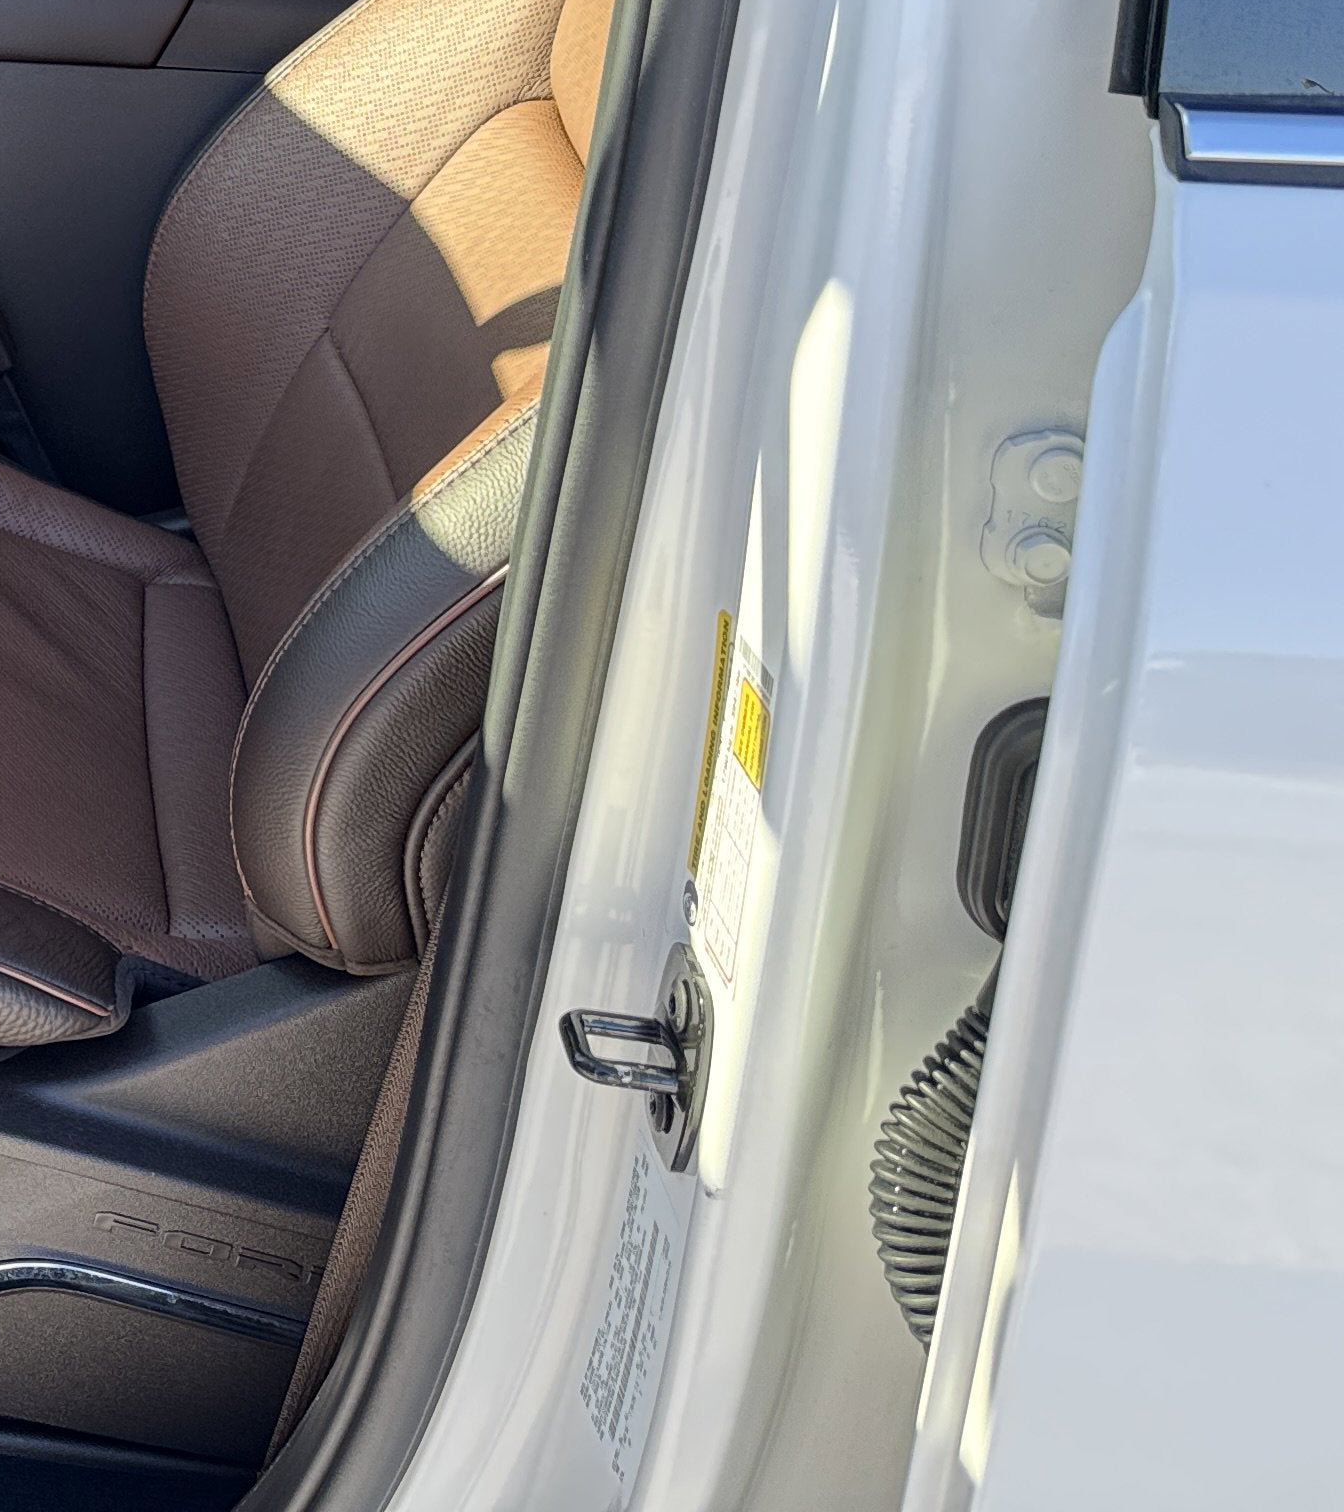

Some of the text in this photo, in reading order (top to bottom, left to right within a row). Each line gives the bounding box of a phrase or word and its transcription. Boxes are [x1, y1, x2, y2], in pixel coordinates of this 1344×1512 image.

[691, 618, 730, 871] TIRE AND LOADING INFORMATION
[92, 1210, 325, 1285] FOR
